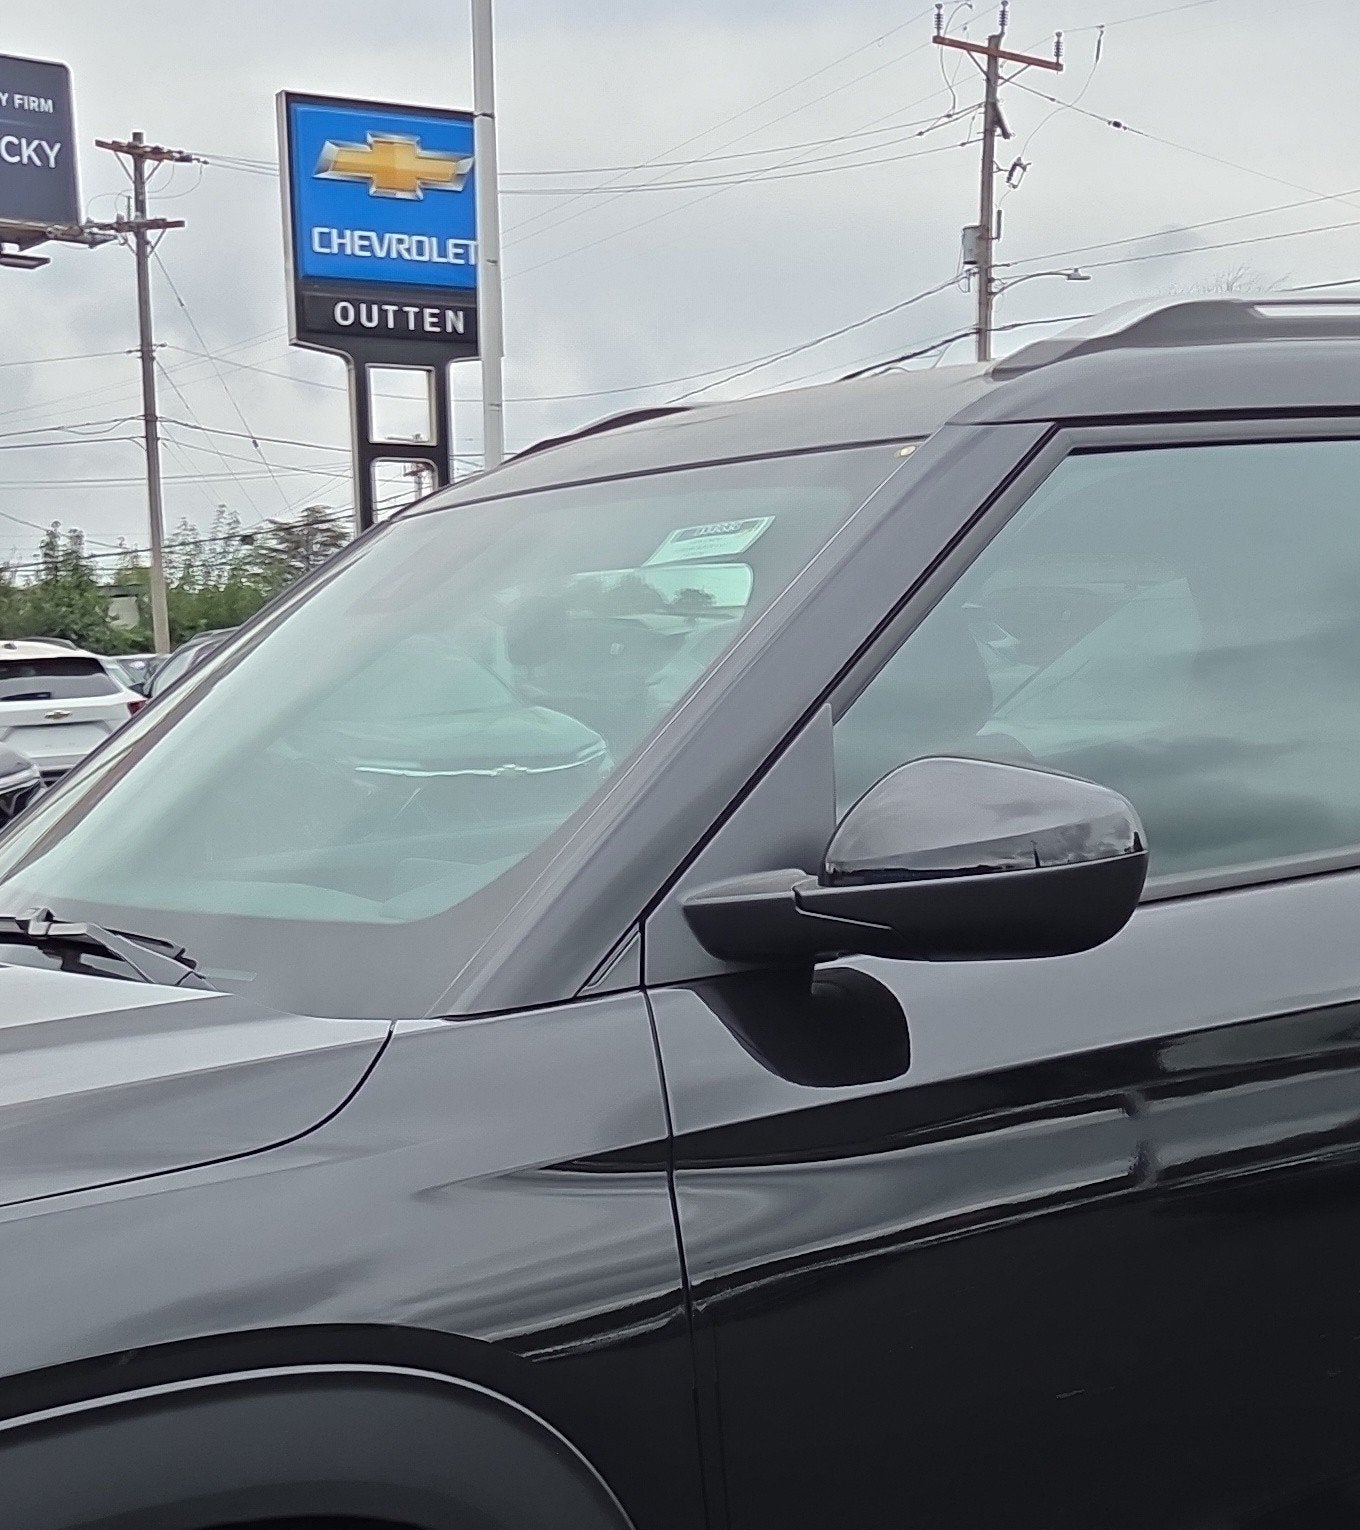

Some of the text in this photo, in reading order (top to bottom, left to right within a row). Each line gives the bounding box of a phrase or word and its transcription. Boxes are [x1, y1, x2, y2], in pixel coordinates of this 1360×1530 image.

[13, 93, 54, 114] FIRM
[311, 226, 479, 266] CHEVROLET
[333, 301, 465, 334] OUTTEN
